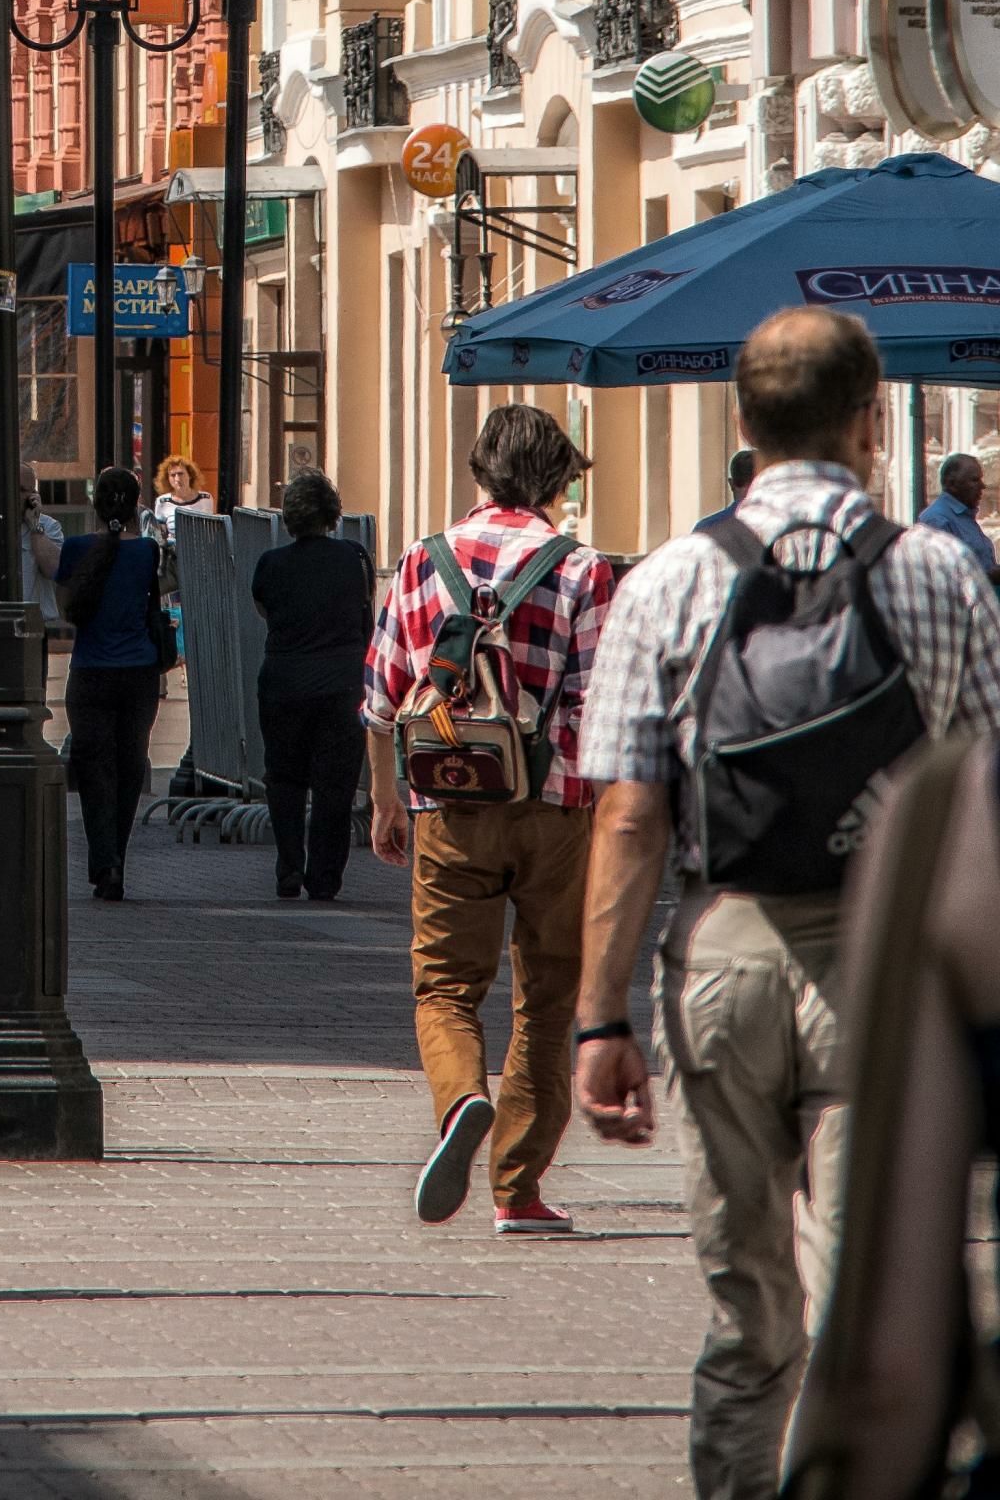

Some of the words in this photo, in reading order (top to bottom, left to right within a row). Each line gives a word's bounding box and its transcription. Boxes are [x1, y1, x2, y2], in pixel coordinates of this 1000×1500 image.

[412, 141, 454, 169] 24
[411, 171, 452, 183] ЧАСА
[638, 350, 727, 371] СИННАБОН
